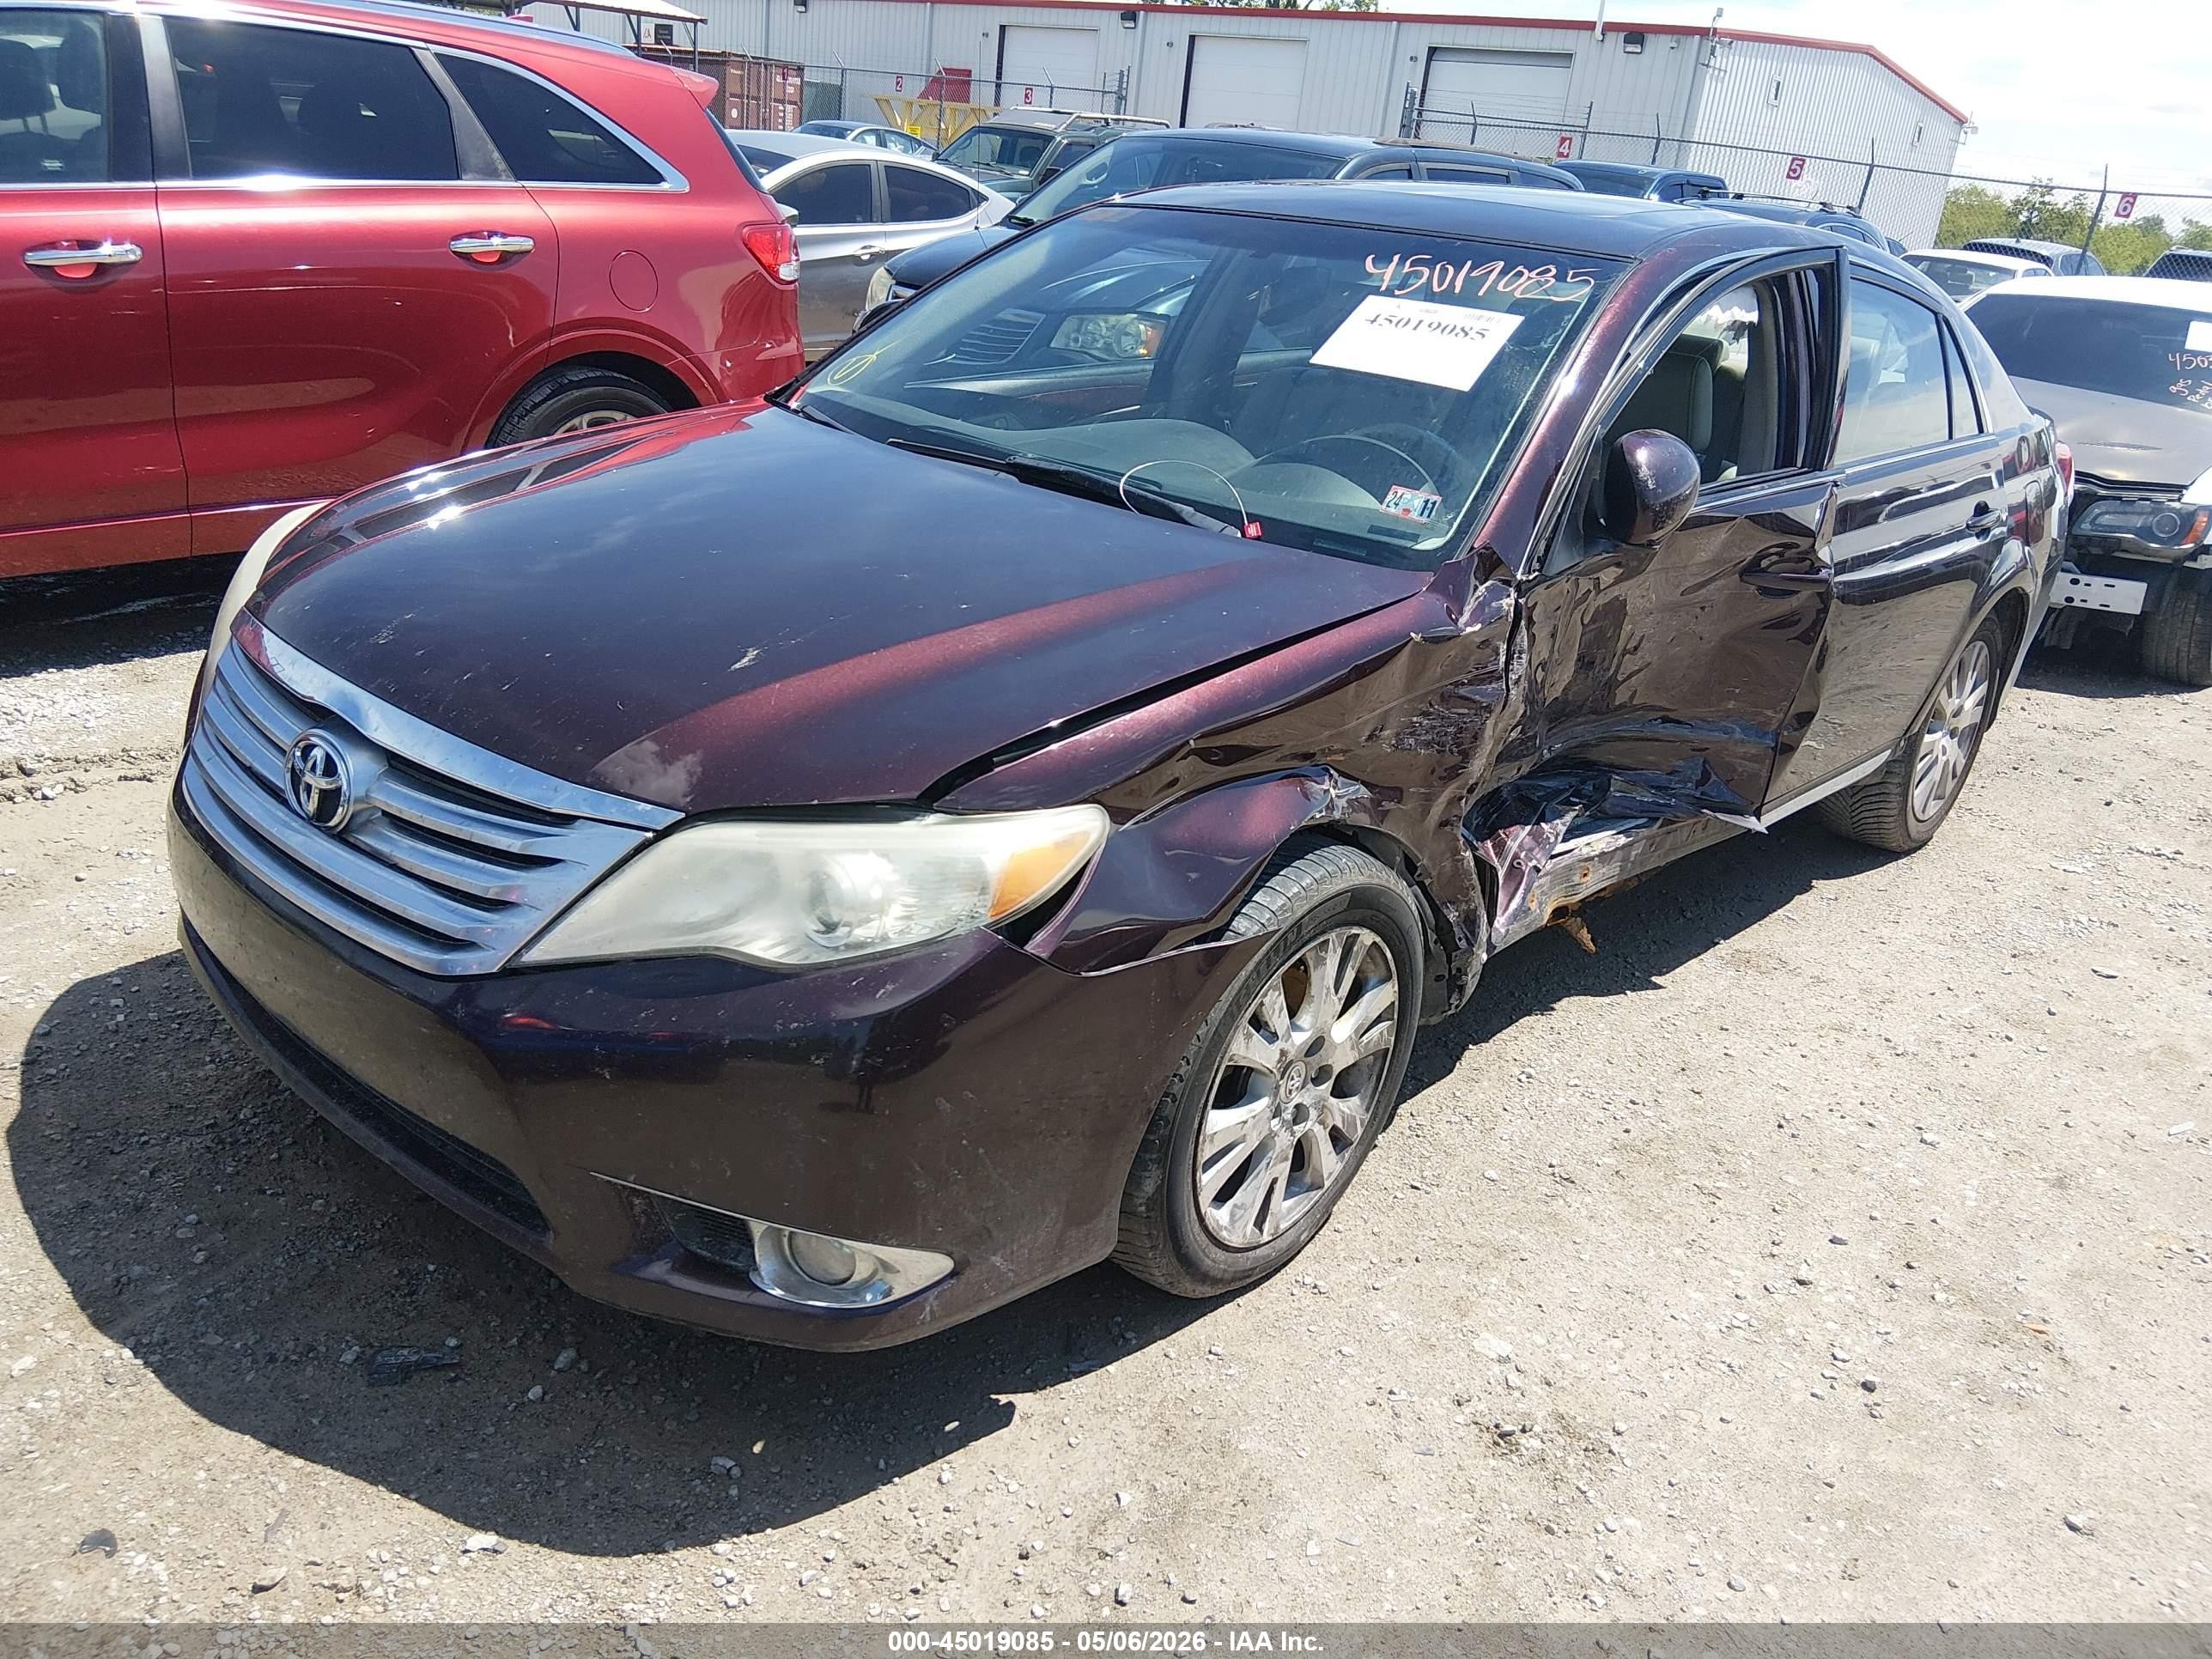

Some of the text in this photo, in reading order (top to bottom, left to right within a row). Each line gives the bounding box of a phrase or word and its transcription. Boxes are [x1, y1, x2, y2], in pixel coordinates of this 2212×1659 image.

[896, 77, 902, 90] 2
[1025, 89, 1032, 103] 3
[1559, 139, 1571, 156] 4
[1789, 160, 1804, 178] 5
[2118, 197, 2135, 216] 6
[1364, 253, 1601, 302] 45019085
[1364, 313, 1491, 341] 45019085
[1385, 490, 1437, 520] 24 11
